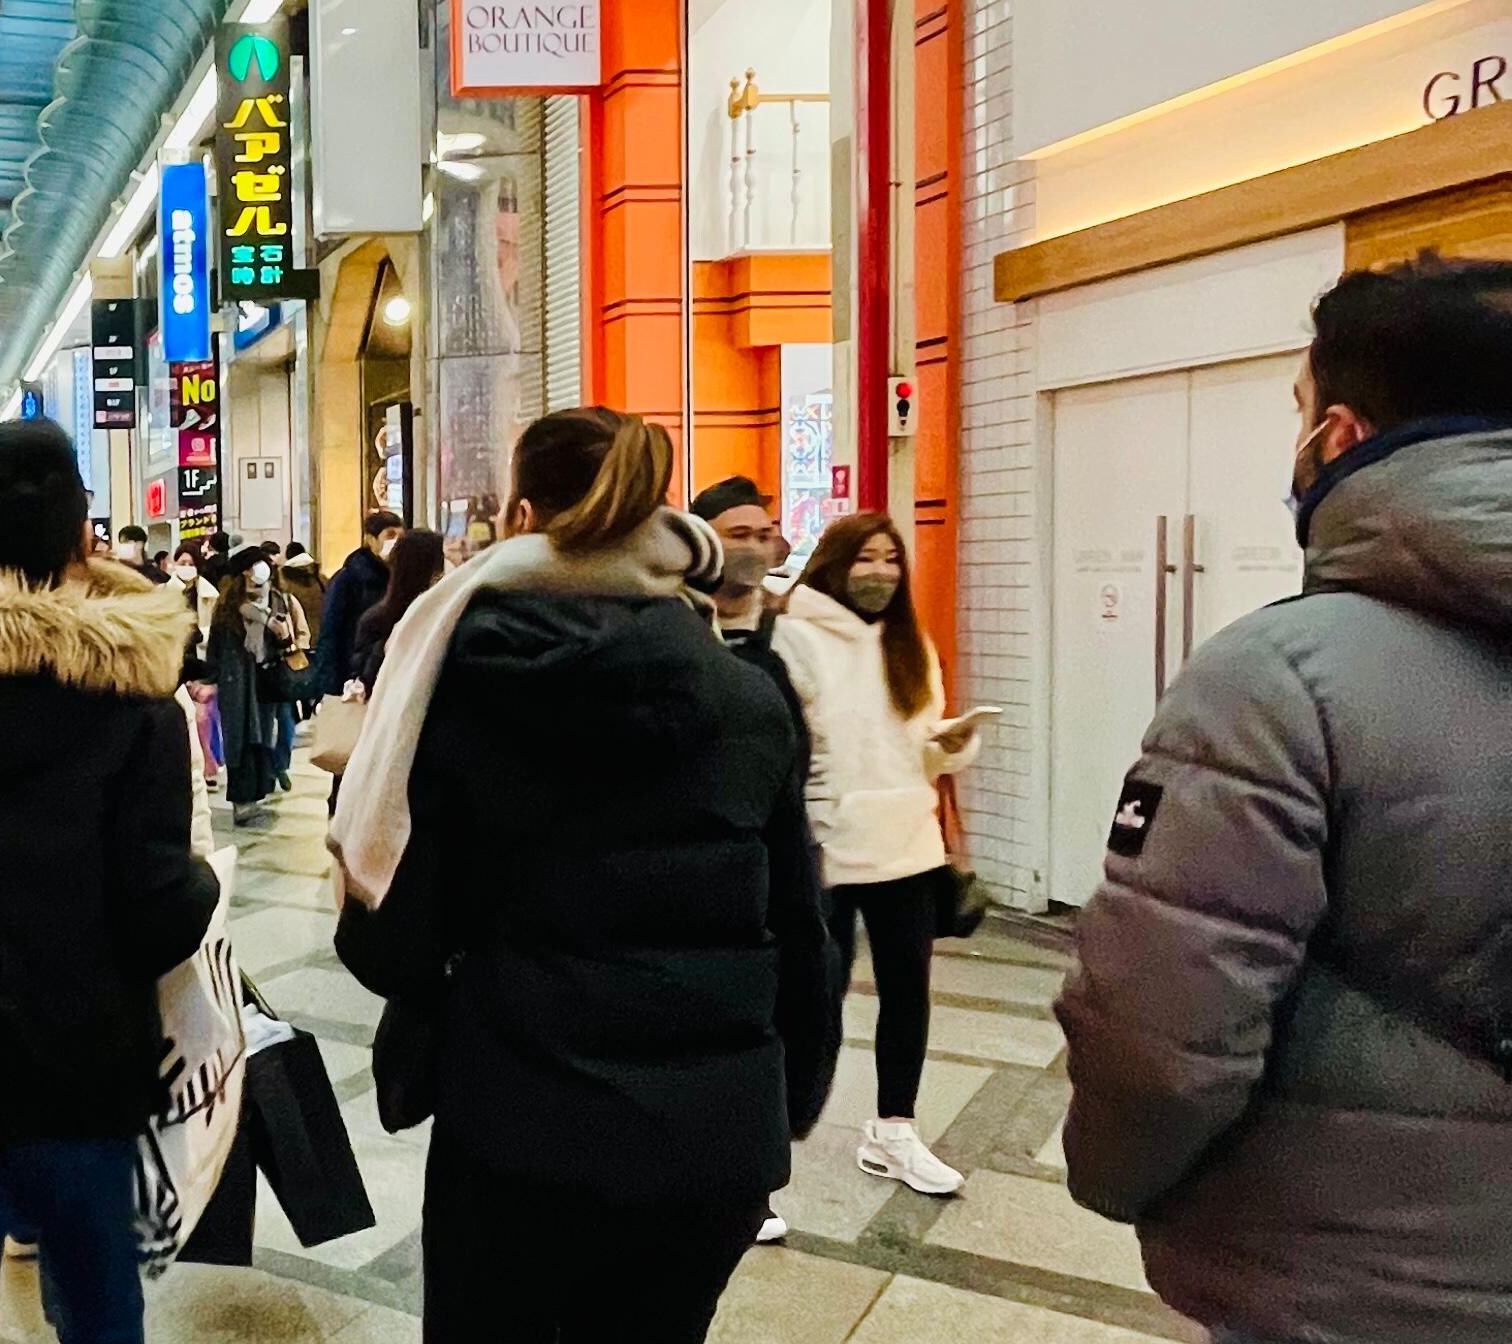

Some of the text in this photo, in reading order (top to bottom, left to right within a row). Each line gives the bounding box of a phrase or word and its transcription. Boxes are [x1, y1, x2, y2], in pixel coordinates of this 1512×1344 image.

[466, 5, 595, 30] ORANGE
[468, 32, 595, 59] BOUTIQUE
[223, 93, 287, 237] バアゼル
[171, 209, 196, 315] atmos
[183, 469, 200, 489] 1F
